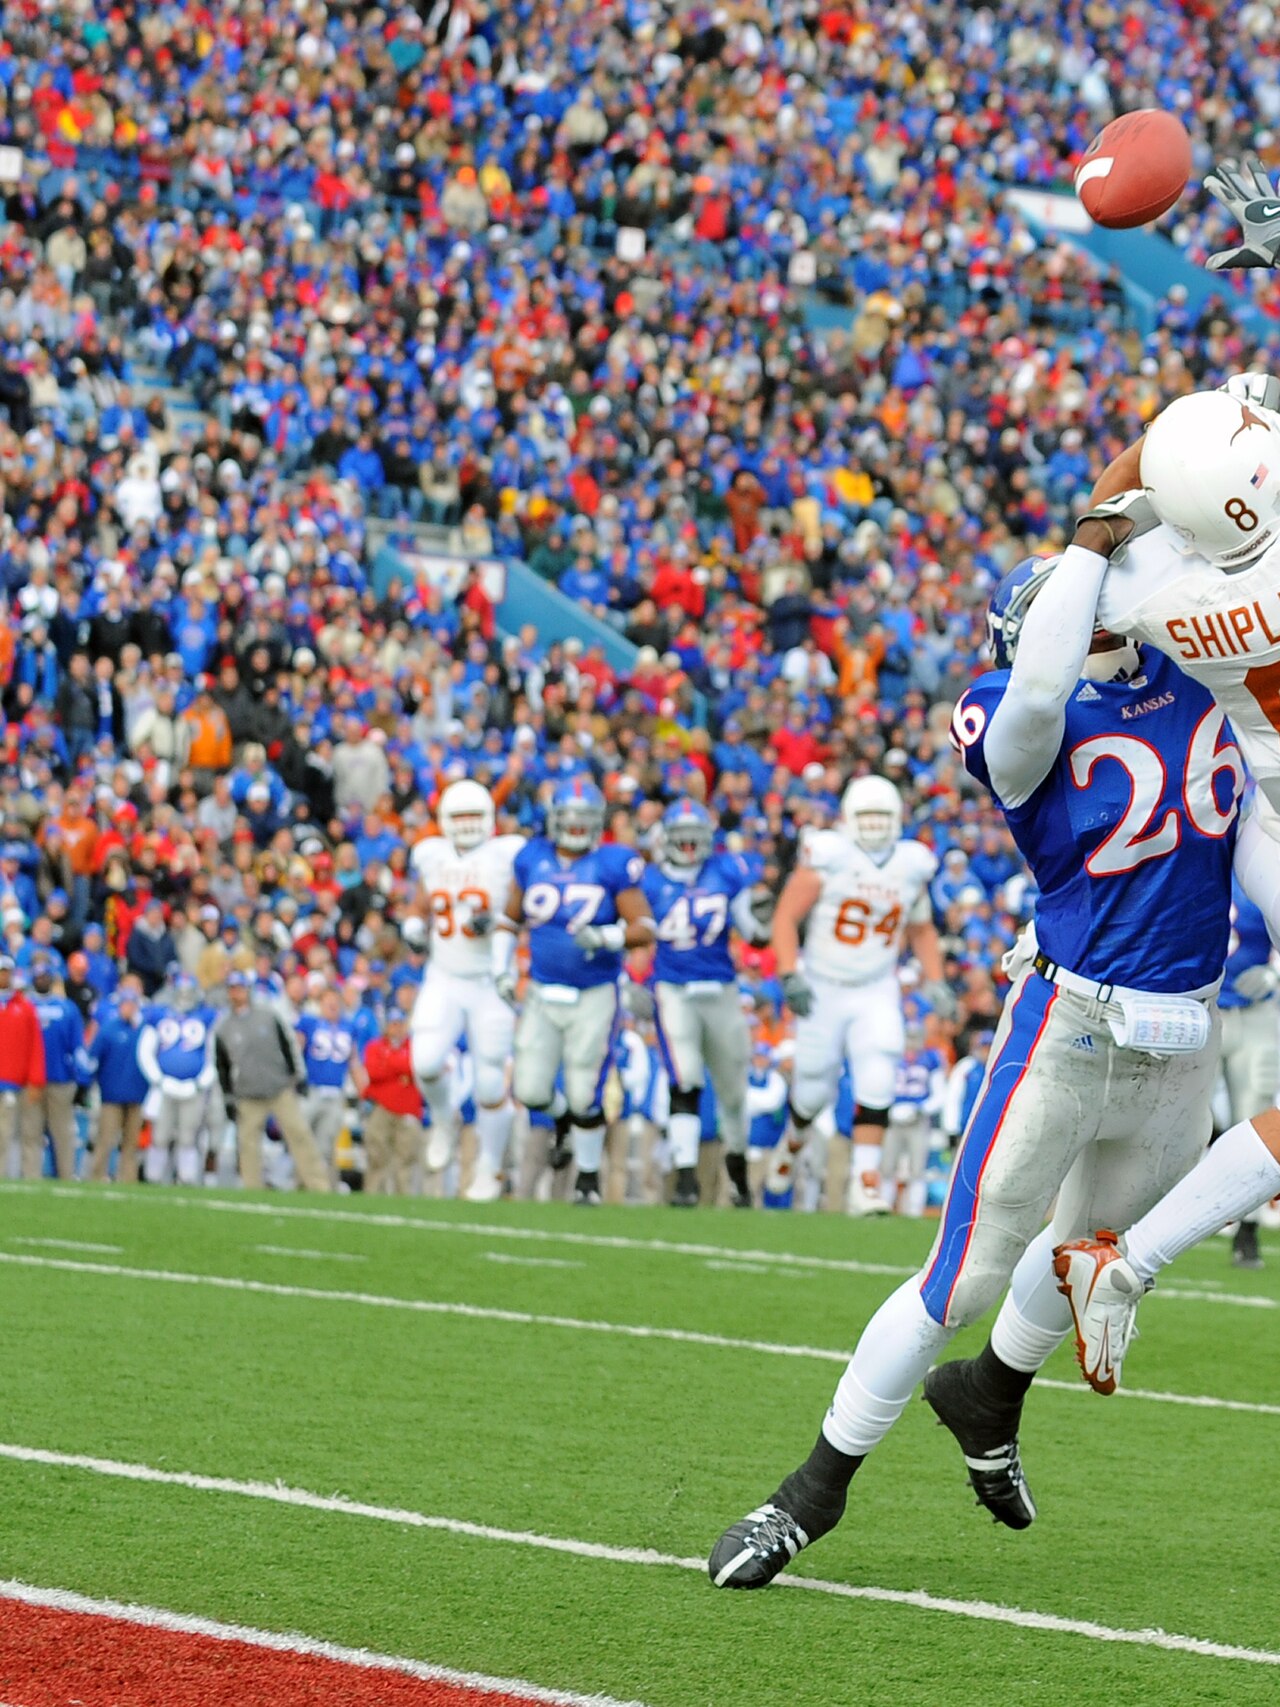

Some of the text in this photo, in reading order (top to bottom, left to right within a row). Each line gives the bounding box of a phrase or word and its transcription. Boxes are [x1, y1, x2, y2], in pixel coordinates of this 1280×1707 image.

[1224, 497, 1259, 532] 8
[1121, 690, 1176, 720] KANSAS
[1068, 702, 1247, 877] 26
[523, 883, 606, 936] 97
[657, 893, 729, 952] 47
[834, 898, 903, 948] 64
[157, 1018, 206, 1052] 99
